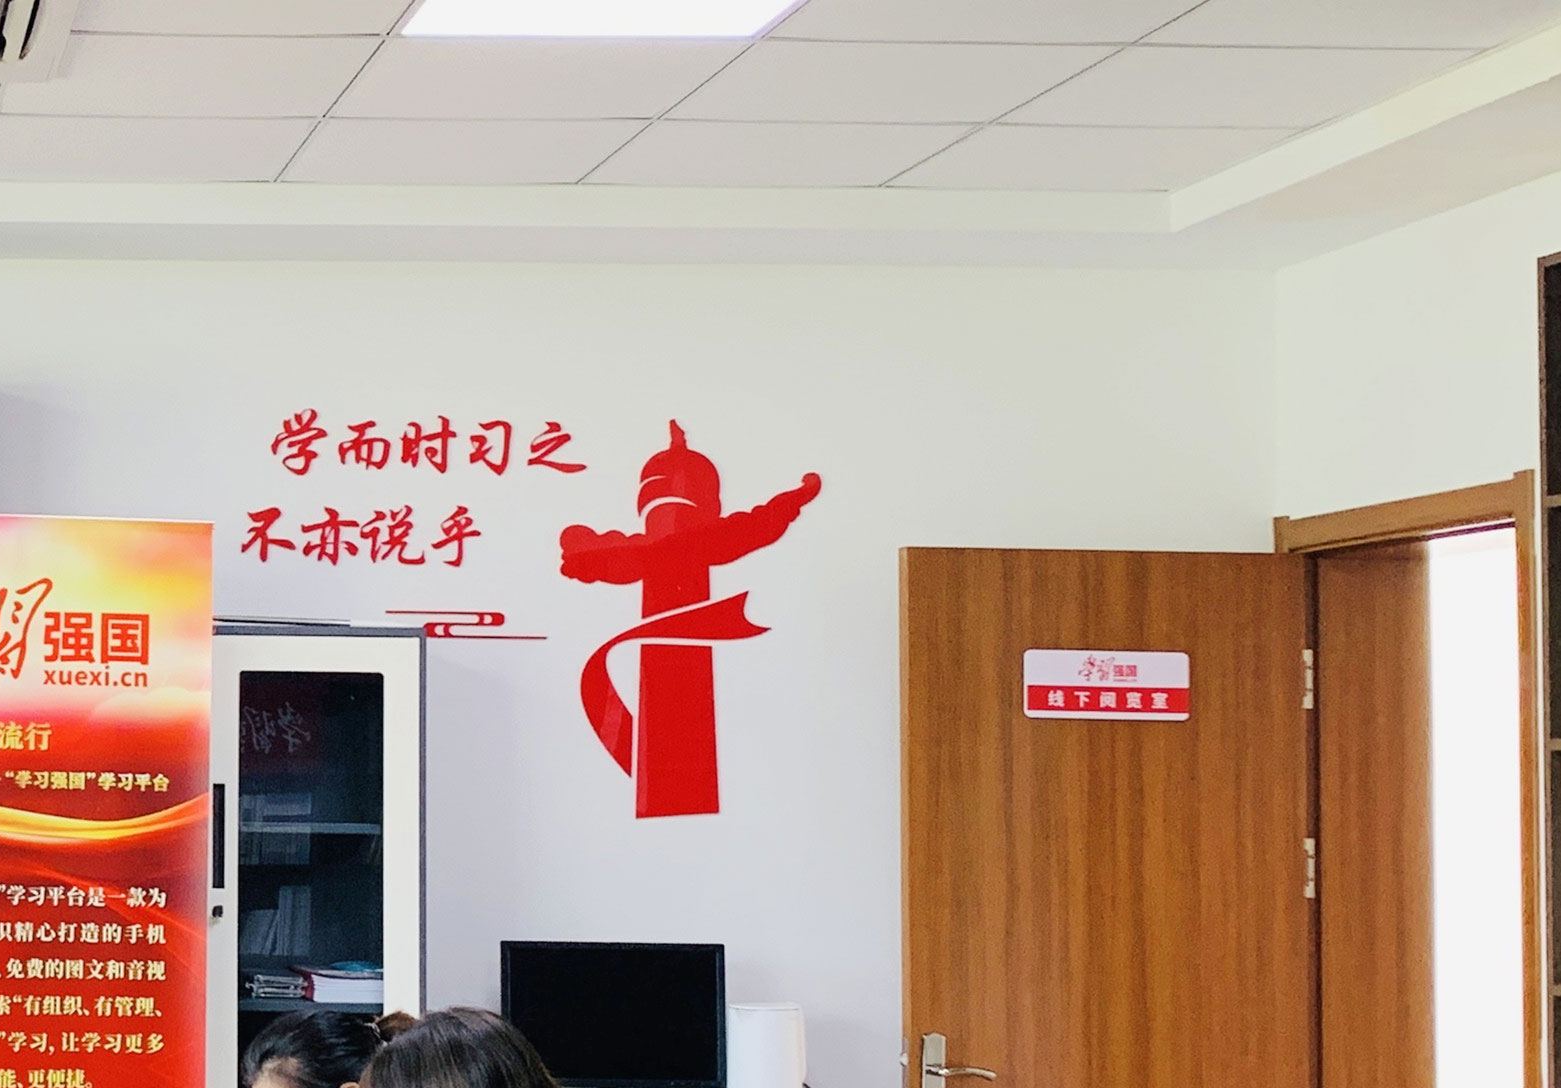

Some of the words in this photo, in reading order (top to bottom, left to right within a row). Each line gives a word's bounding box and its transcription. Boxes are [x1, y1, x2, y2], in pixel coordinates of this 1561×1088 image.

[271, 409, 587, 476] 学而时习之
[240, 505, 482, 567] 不亦说乎
[43, 665, 149, 688] xuexi.cn
